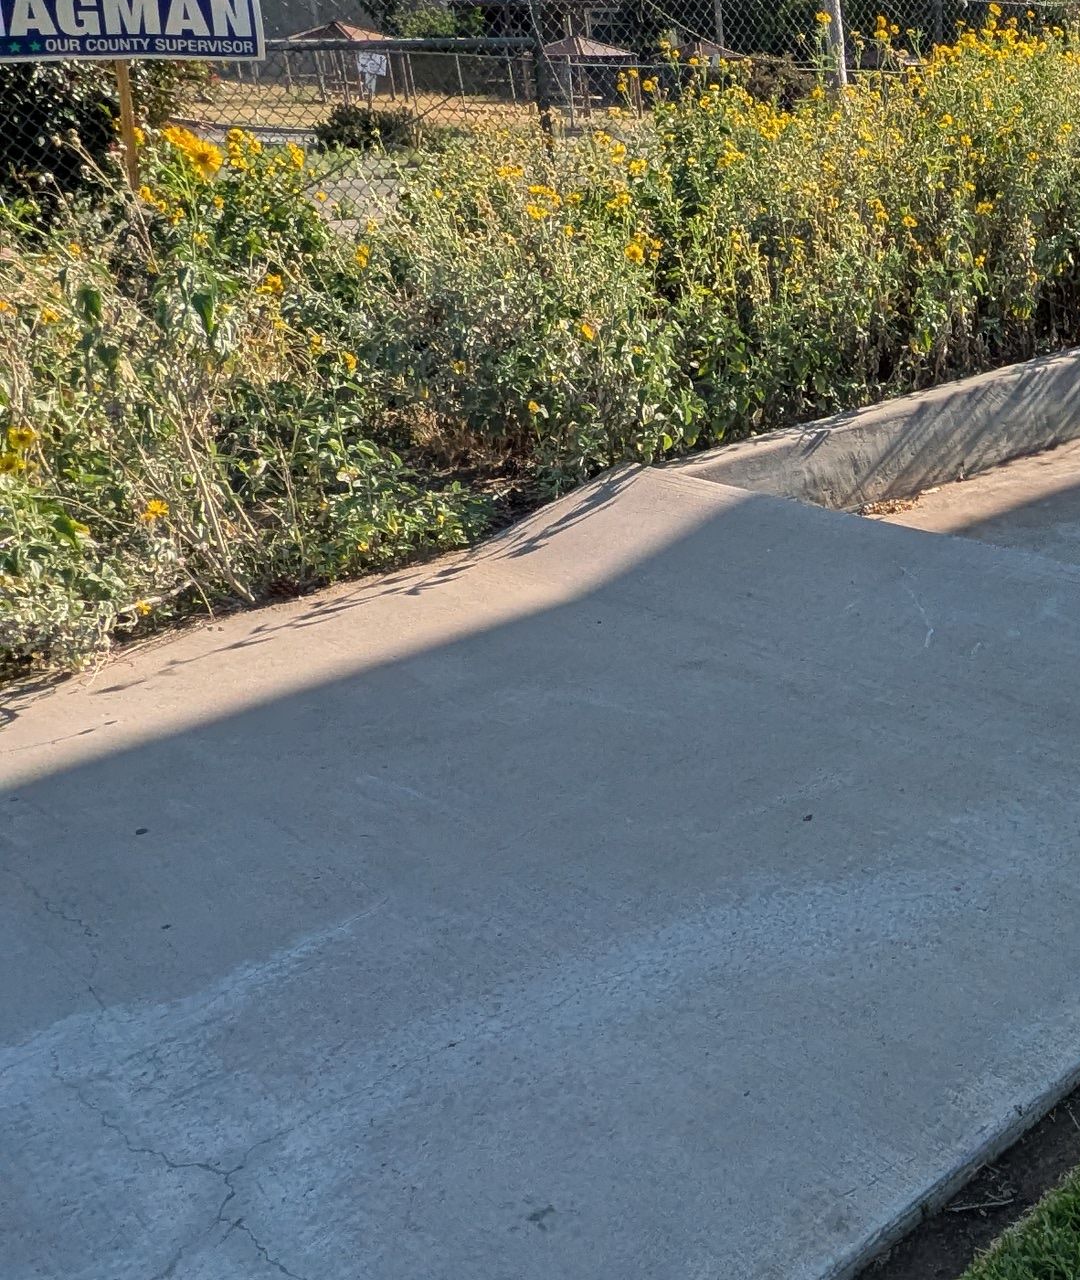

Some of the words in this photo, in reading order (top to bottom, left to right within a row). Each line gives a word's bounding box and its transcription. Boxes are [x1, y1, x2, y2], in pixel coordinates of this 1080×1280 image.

[45, 38, 81, 52] OUR
[85, 38, 150, 52] COUNTY
[155, 39, 254, 53] SUPERVISOR
